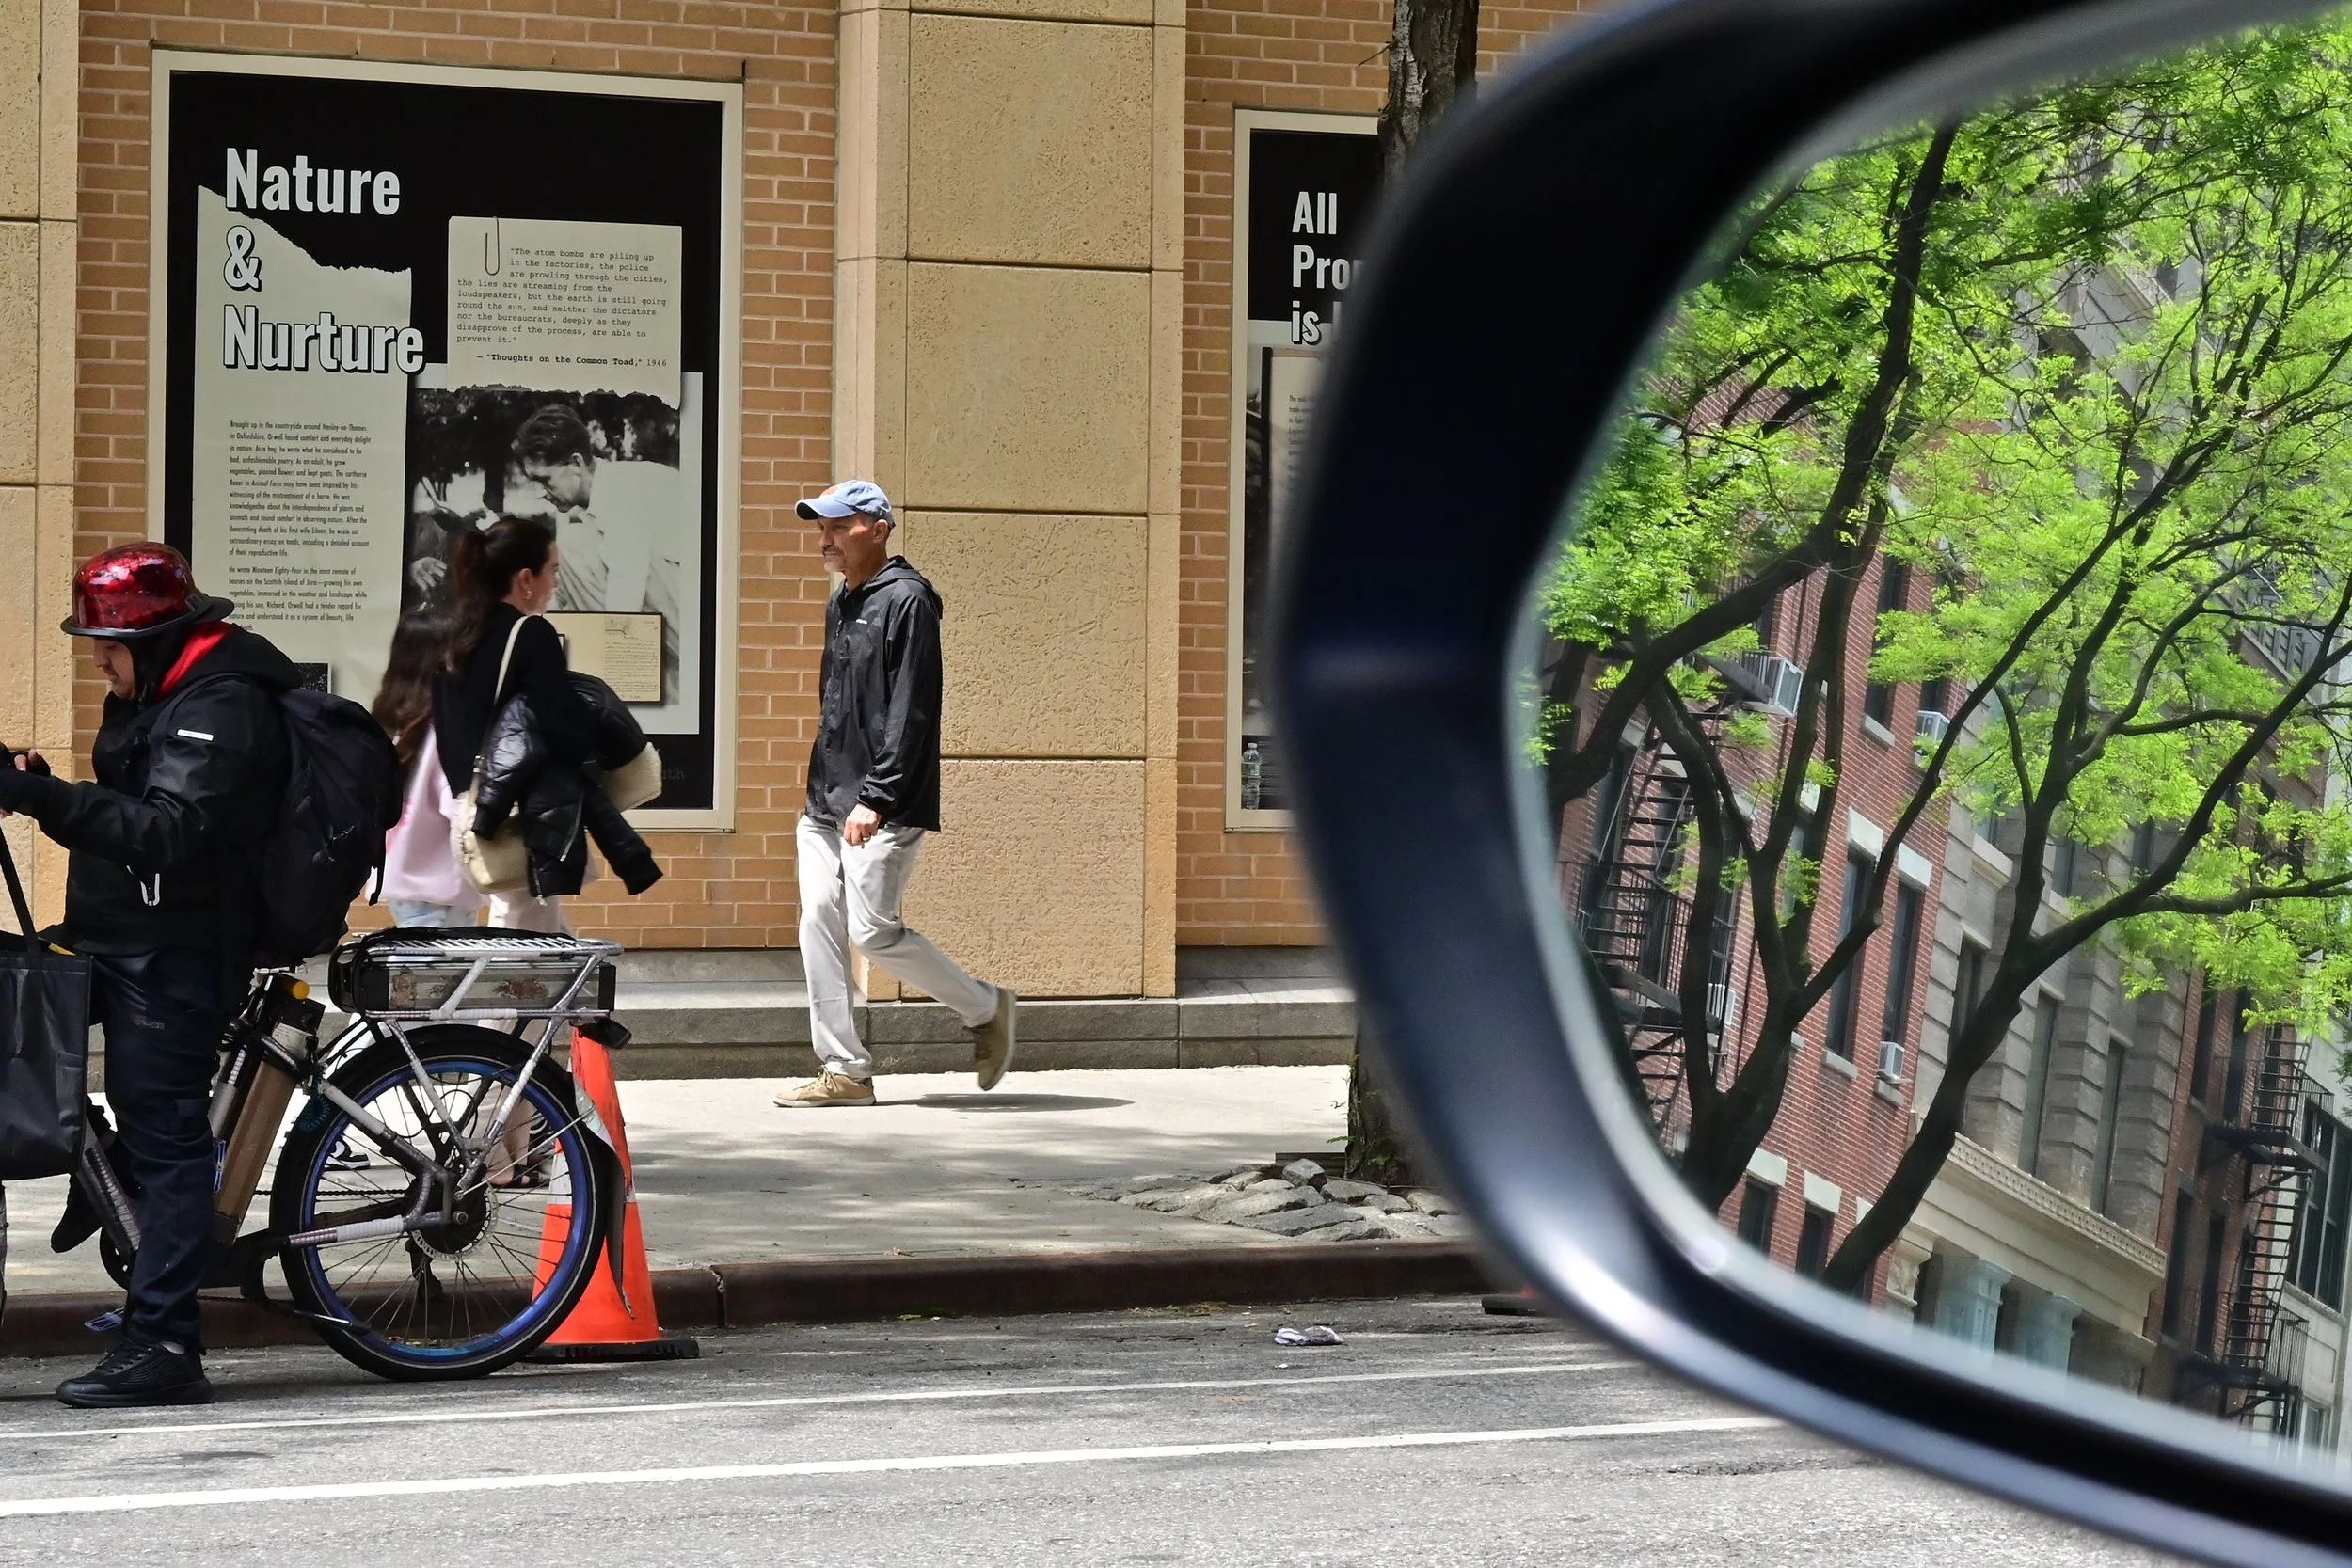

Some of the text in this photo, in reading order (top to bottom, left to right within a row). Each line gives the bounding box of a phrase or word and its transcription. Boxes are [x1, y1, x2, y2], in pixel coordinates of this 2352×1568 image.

[226, 147, 400, 215] Nature
[1292, 191, 1337, 235] All
[224, 225, 262, 292] &
[609, 252, 639, 261] piling
[545, 260, 594, 270] factories,
[529, 271, 569, 280] prowling
[574, 272, 609, 282] through
[522, 282, 567, 292] streaming
[458, 290, 521, 300] loudspeakers,
[641, 297, 666, 306] going
[612, 307, 656, 315] dictators
[497, 313, 556, 323] bureaucrats,
[562, 316, 592, 325] deeply
[612, 318, 631, 327] they
[1292, 300, 1323, 345] is
[456, 323, 507, 332] disapprove
[223, 304, 425, 374] Nurture
[646, 358, 667, 367] 1946
